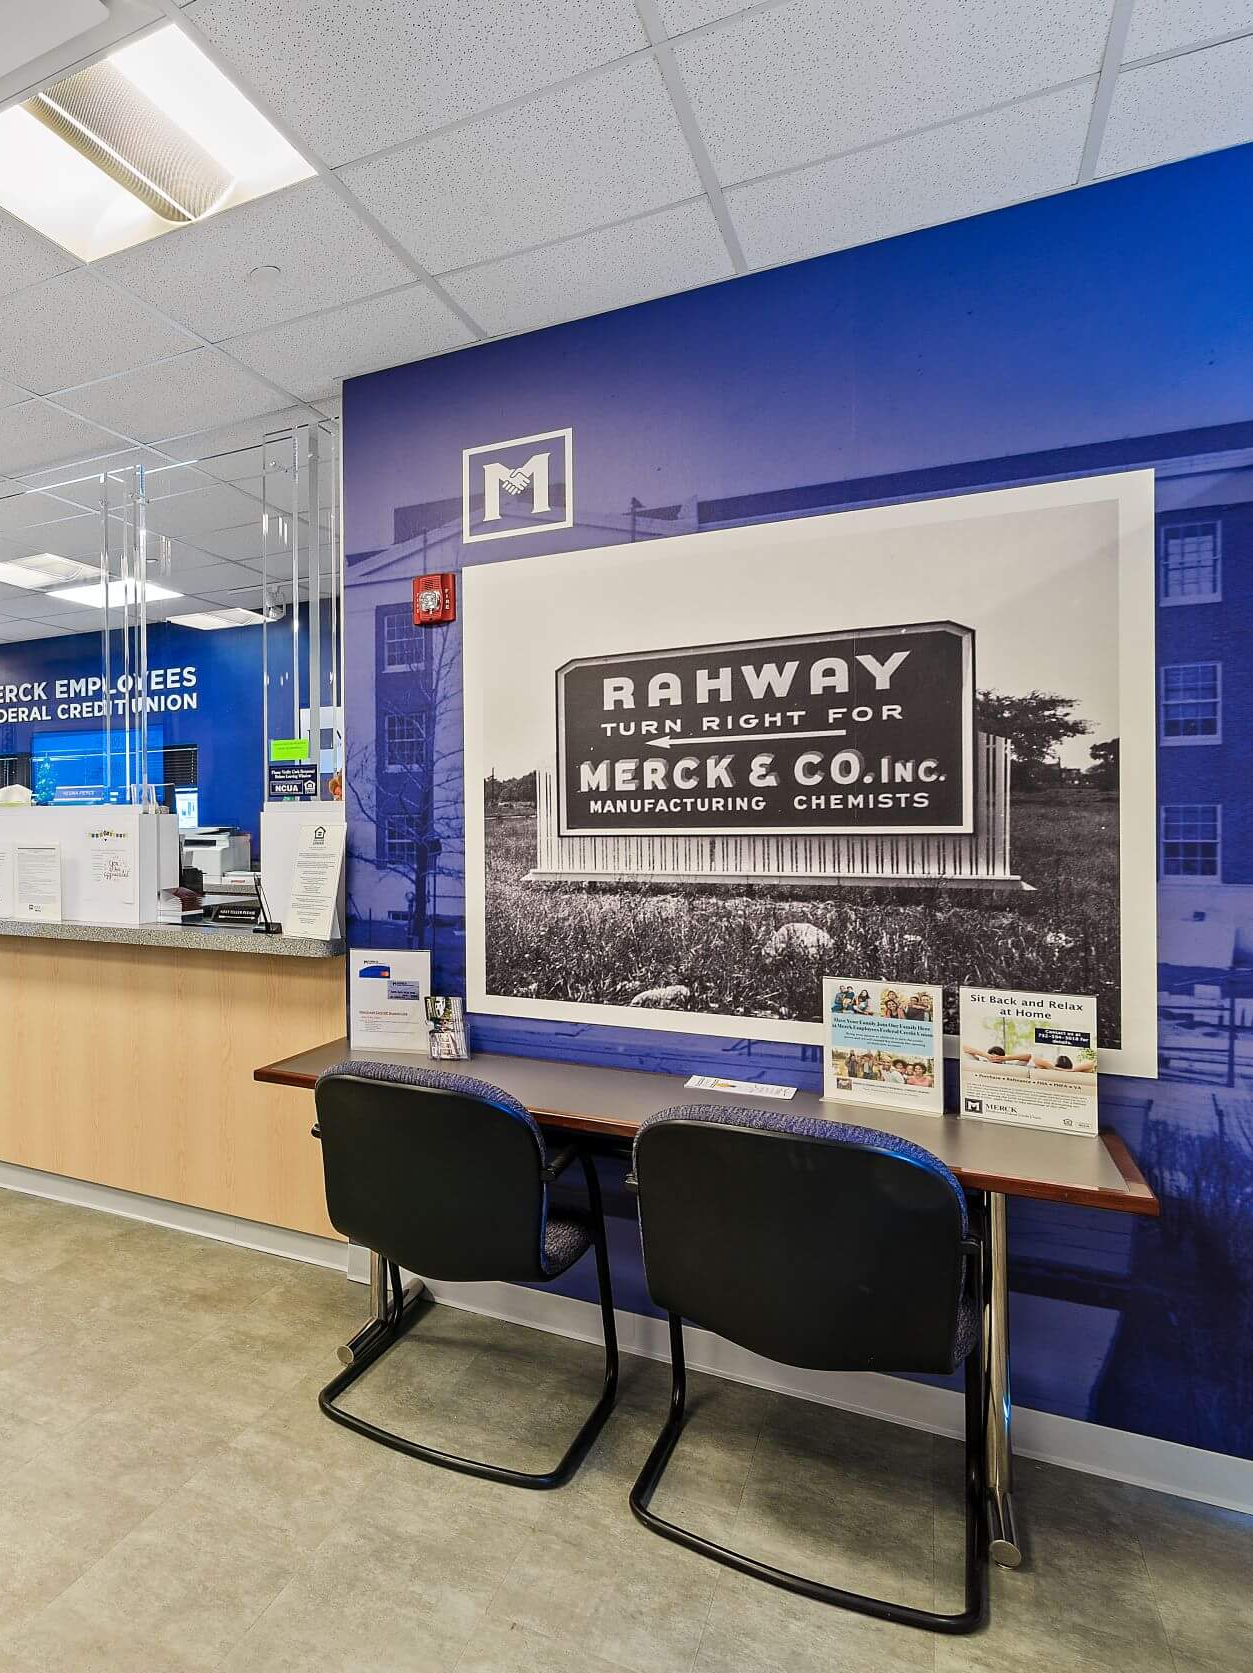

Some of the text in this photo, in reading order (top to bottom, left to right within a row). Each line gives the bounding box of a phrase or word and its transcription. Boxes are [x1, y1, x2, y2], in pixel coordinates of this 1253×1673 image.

[483, 452, 552, 522] M
[55, 666, 197, 699] EMPLOYEES
[603, 650, 911, 711] RAHWAY
[57, 699, 127, 720] CREDIT
[131, 692, 197, 714] UNION
[601, 704, 904, 737] TURN RIGHT FOR
[579, 754, 736, 793] MERCK
[748, 752, 780, 788] &
[275, 784, 299, 792] NCUA
[589, 792, 929, 814] MANUFACTURING CHEMISTS
[970, 994, 1084, 1011] Sit Back and Relax
[999, 1008, 1052, 1020] at Home
[853, 1024, 880, 1033] Employees
[986, 1103, 1018, 1114] MERCK
